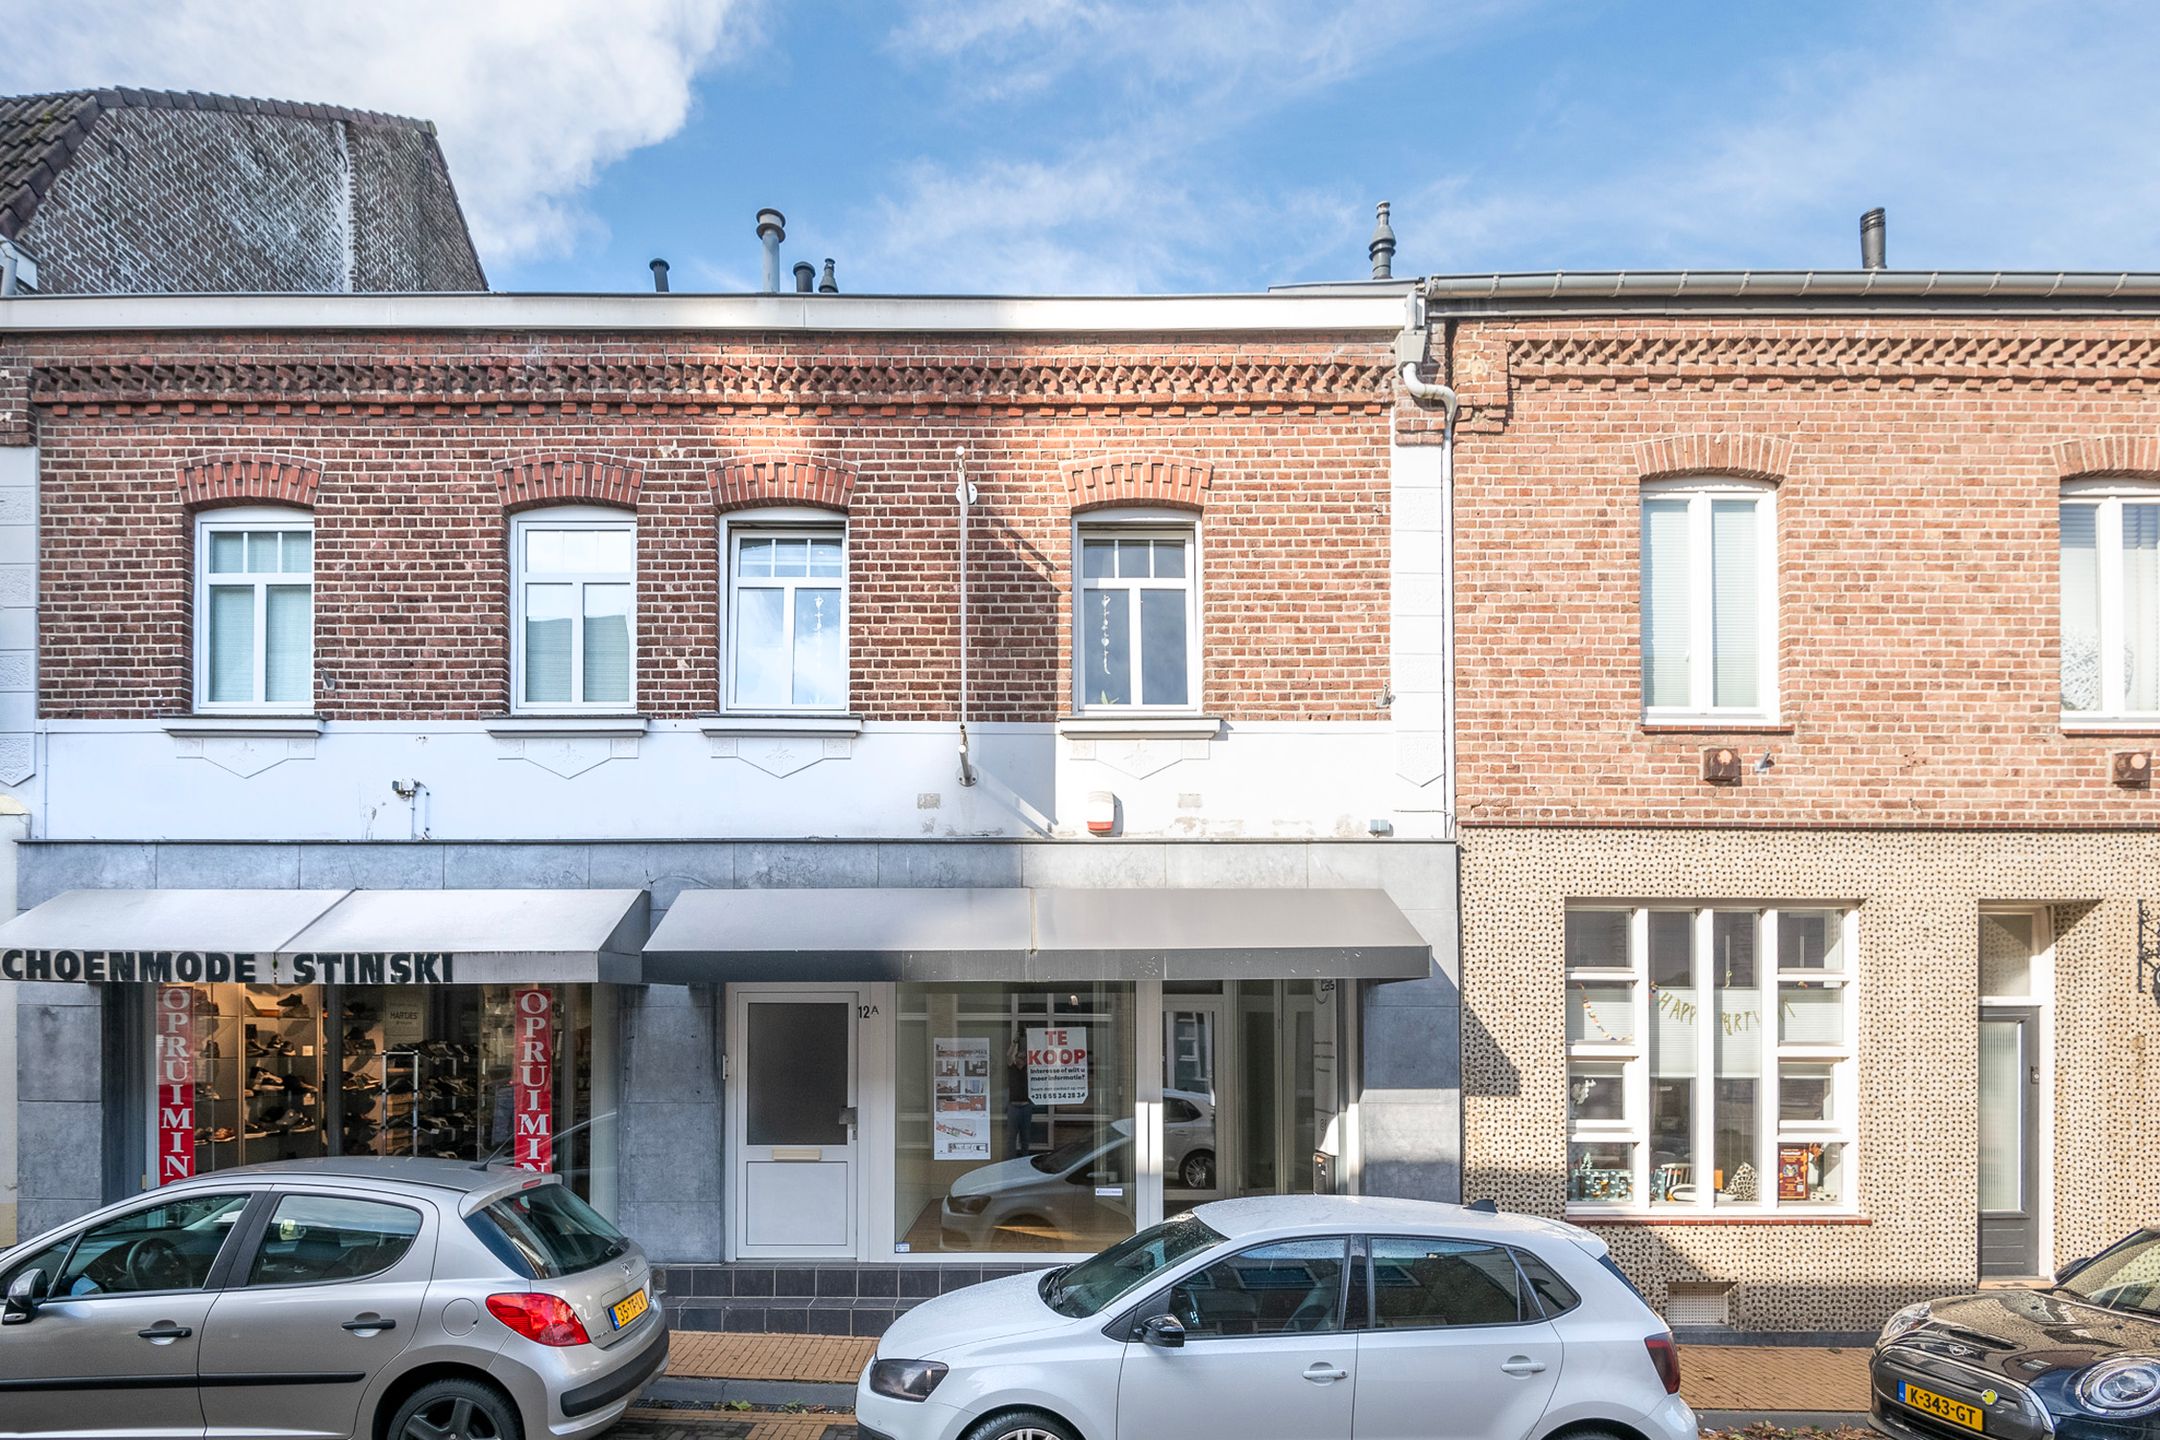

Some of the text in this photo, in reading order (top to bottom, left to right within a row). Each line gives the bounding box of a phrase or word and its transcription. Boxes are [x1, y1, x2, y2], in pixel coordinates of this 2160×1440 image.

[0, 949, 453, 984] CHOENMODE STINSKI
[1045, 1031, 1068, 1046] TE
[1028, 1049, 1086, 1066] KOOP
[161, 988, 193, 1184] OPRUIMIN
[1910, 1388, 1976, 1425] K-343-GT
